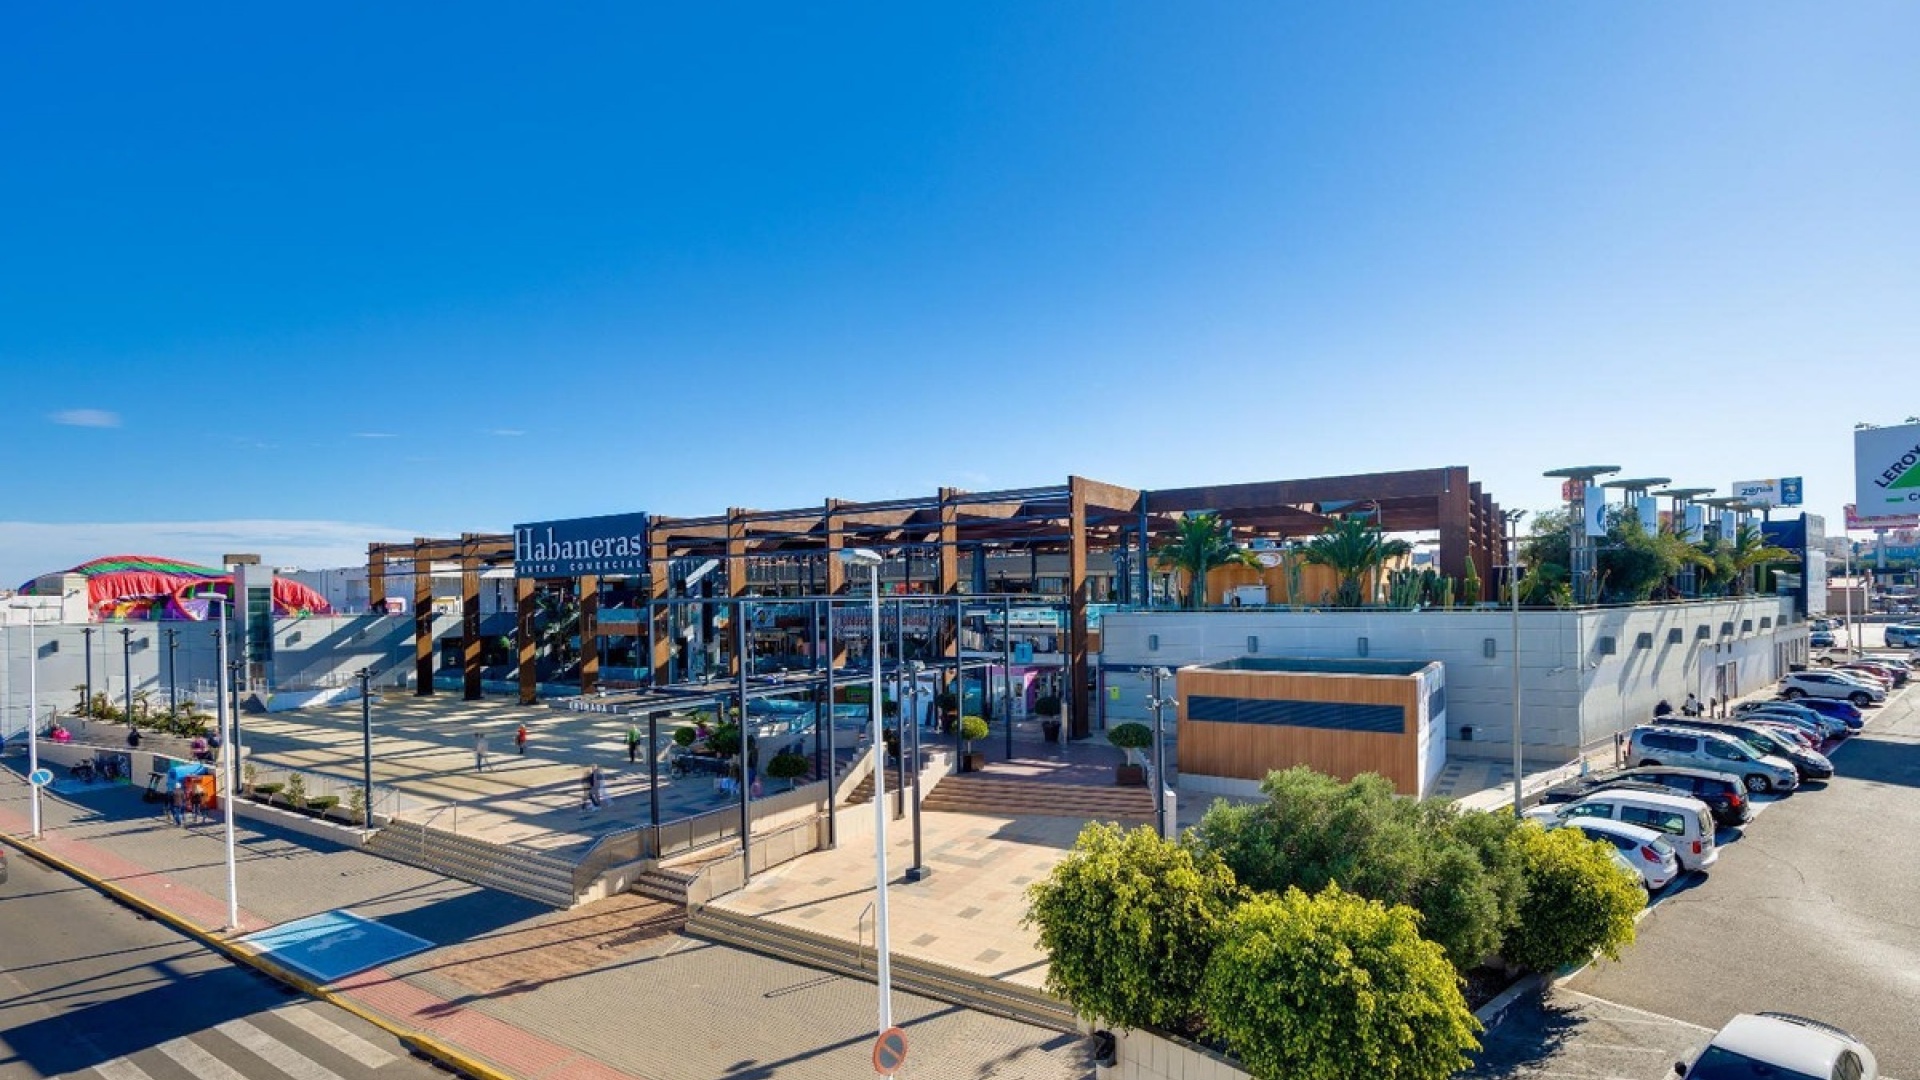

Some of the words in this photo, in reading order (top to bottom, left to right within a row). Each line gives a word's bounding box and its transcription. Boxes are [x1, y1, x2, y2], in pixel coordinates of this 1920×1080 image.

[1873, 444, 1920, 488] LEROY
[1908, 492, 1920, 502] C
[514, 527, 642, 561] Habaneras
[569, 559, 643, 572] COMERCIAL
